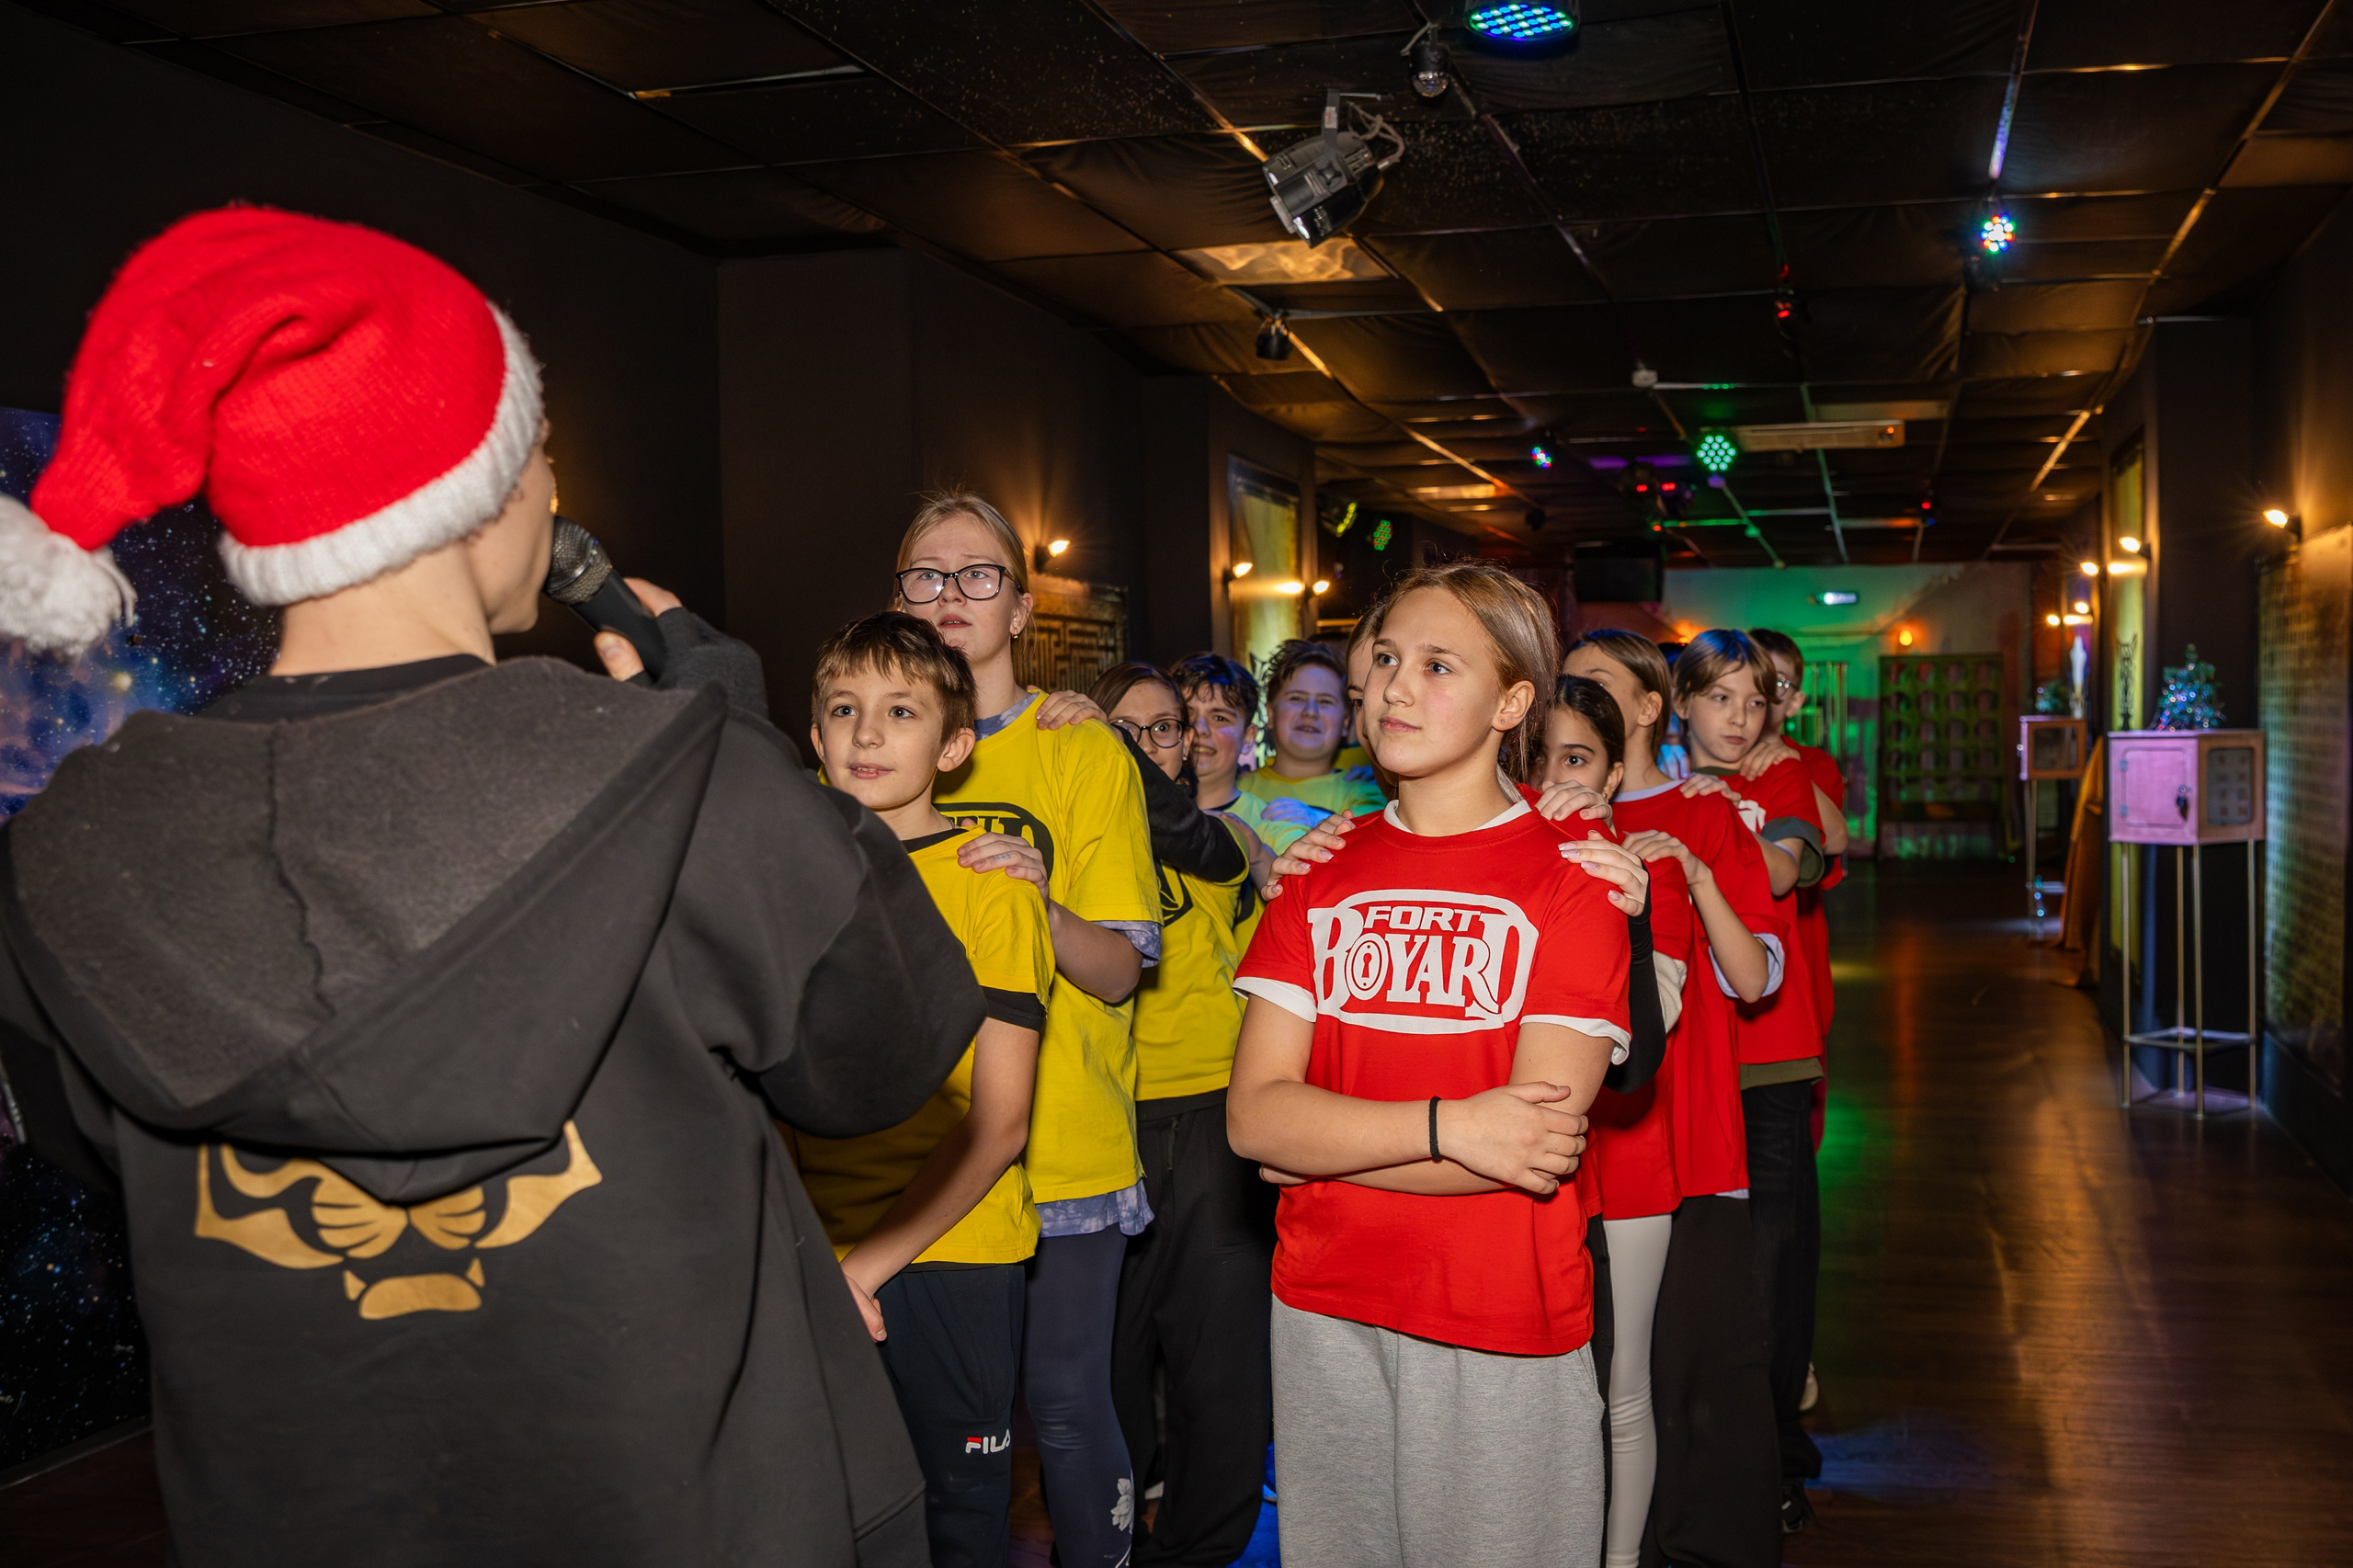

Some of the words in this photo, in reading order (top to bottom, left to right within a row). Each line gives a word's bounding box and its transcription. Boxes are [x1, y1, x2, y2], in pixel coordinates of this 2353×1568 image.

[1363, 905, 1481, 932] FORT
[1307, 905, 1540, 1017] BOYARD
[965, 1428, 1011, 1454] FILA
